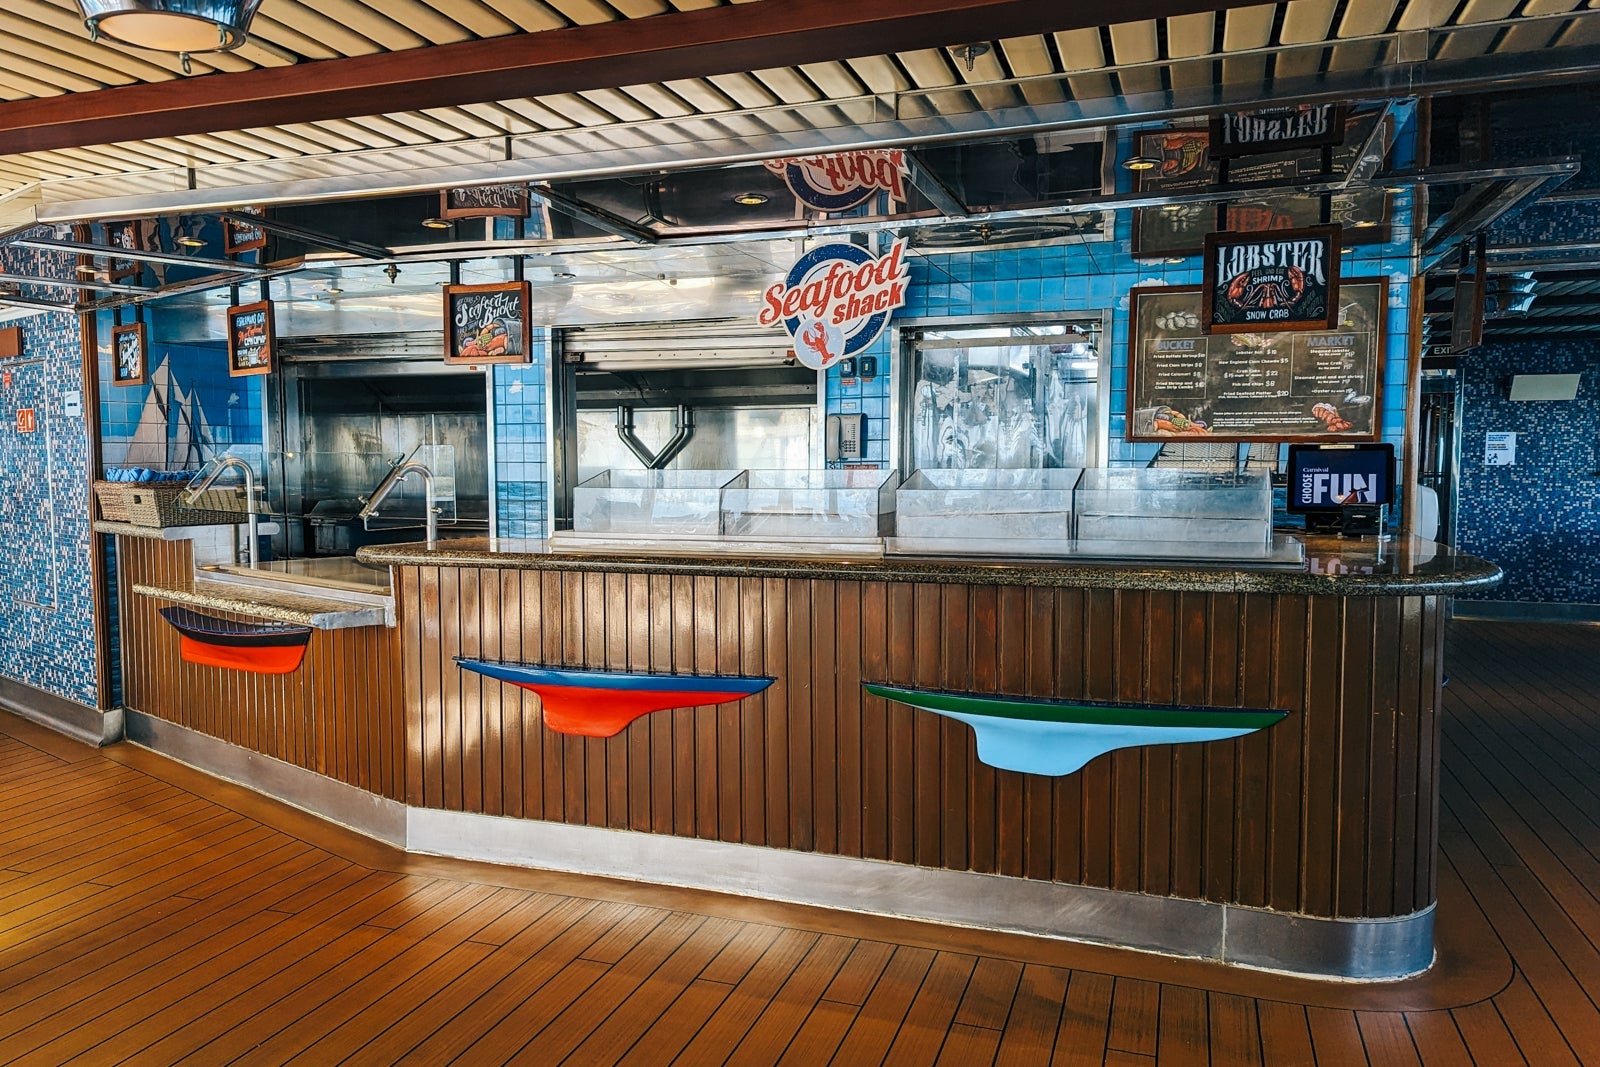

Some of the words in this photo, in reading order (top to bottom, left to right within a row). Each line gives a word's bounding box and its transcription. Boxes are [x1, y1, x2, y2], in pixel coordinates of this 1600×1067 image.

[1217, 240, 1326, 287] LOBSTER
[1252, 269, 1262, 277] PEEL
[759, 243, 902, 325] Seafood
[1252, 275, 1284, 285] SHRIMP
[456, 293, 504, 327] Seafood
[479, 296, 519, 328] Bucket
[832, 282, 903, 325] shack
[1246, 310, 1266, 320] SNOW
[1269, 309, 1289, 320] CRAB
[1157, 340, 1195, 350] BUCKET
[1307, 336, 1354, 346] MARKET
[1302, 474, 1313, 504] CHOOSE
[1313, 474, 1376, 504] FUN
